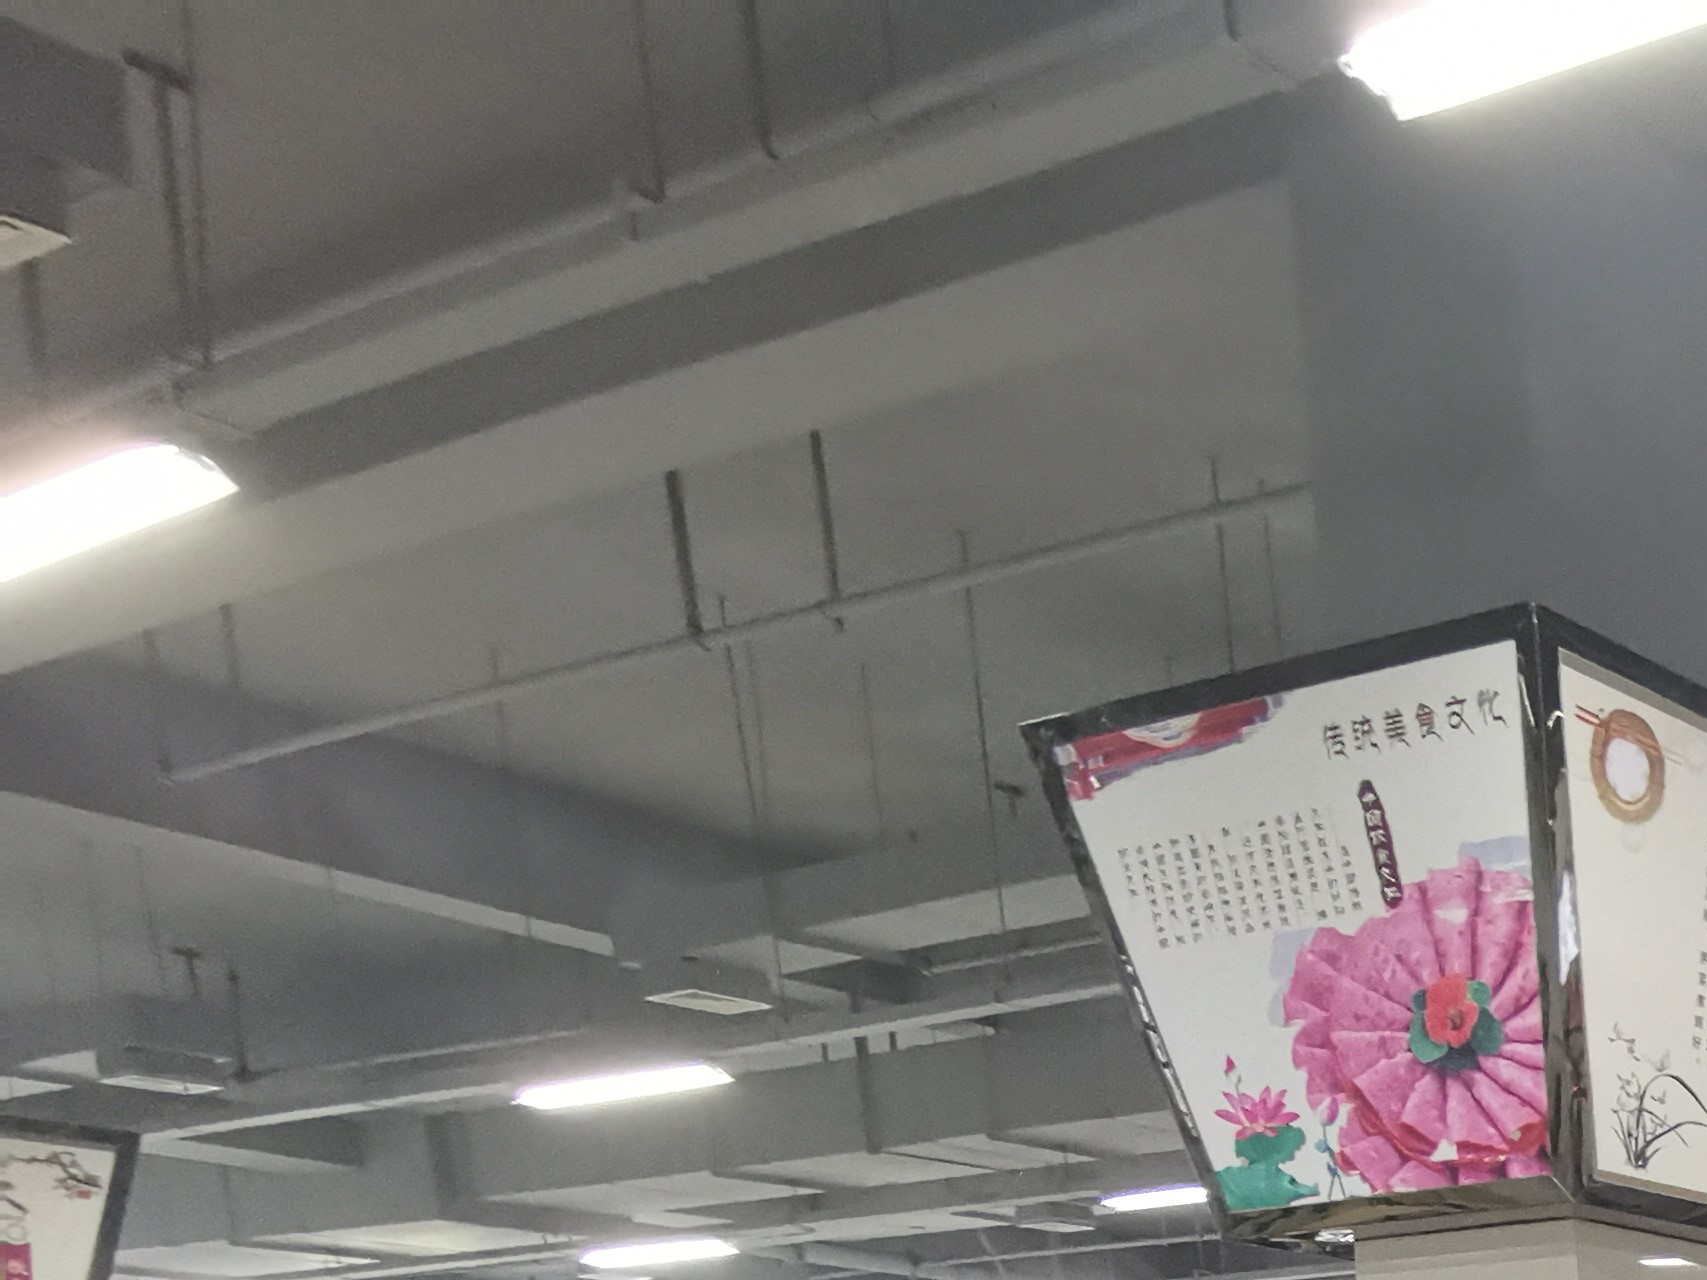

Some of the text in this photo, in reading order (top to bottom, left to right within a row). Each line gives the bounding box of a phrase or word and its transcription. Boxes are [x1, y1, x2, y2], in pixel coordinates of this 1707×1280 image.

[1323, 688, 1509, 760] 传统美食文化
